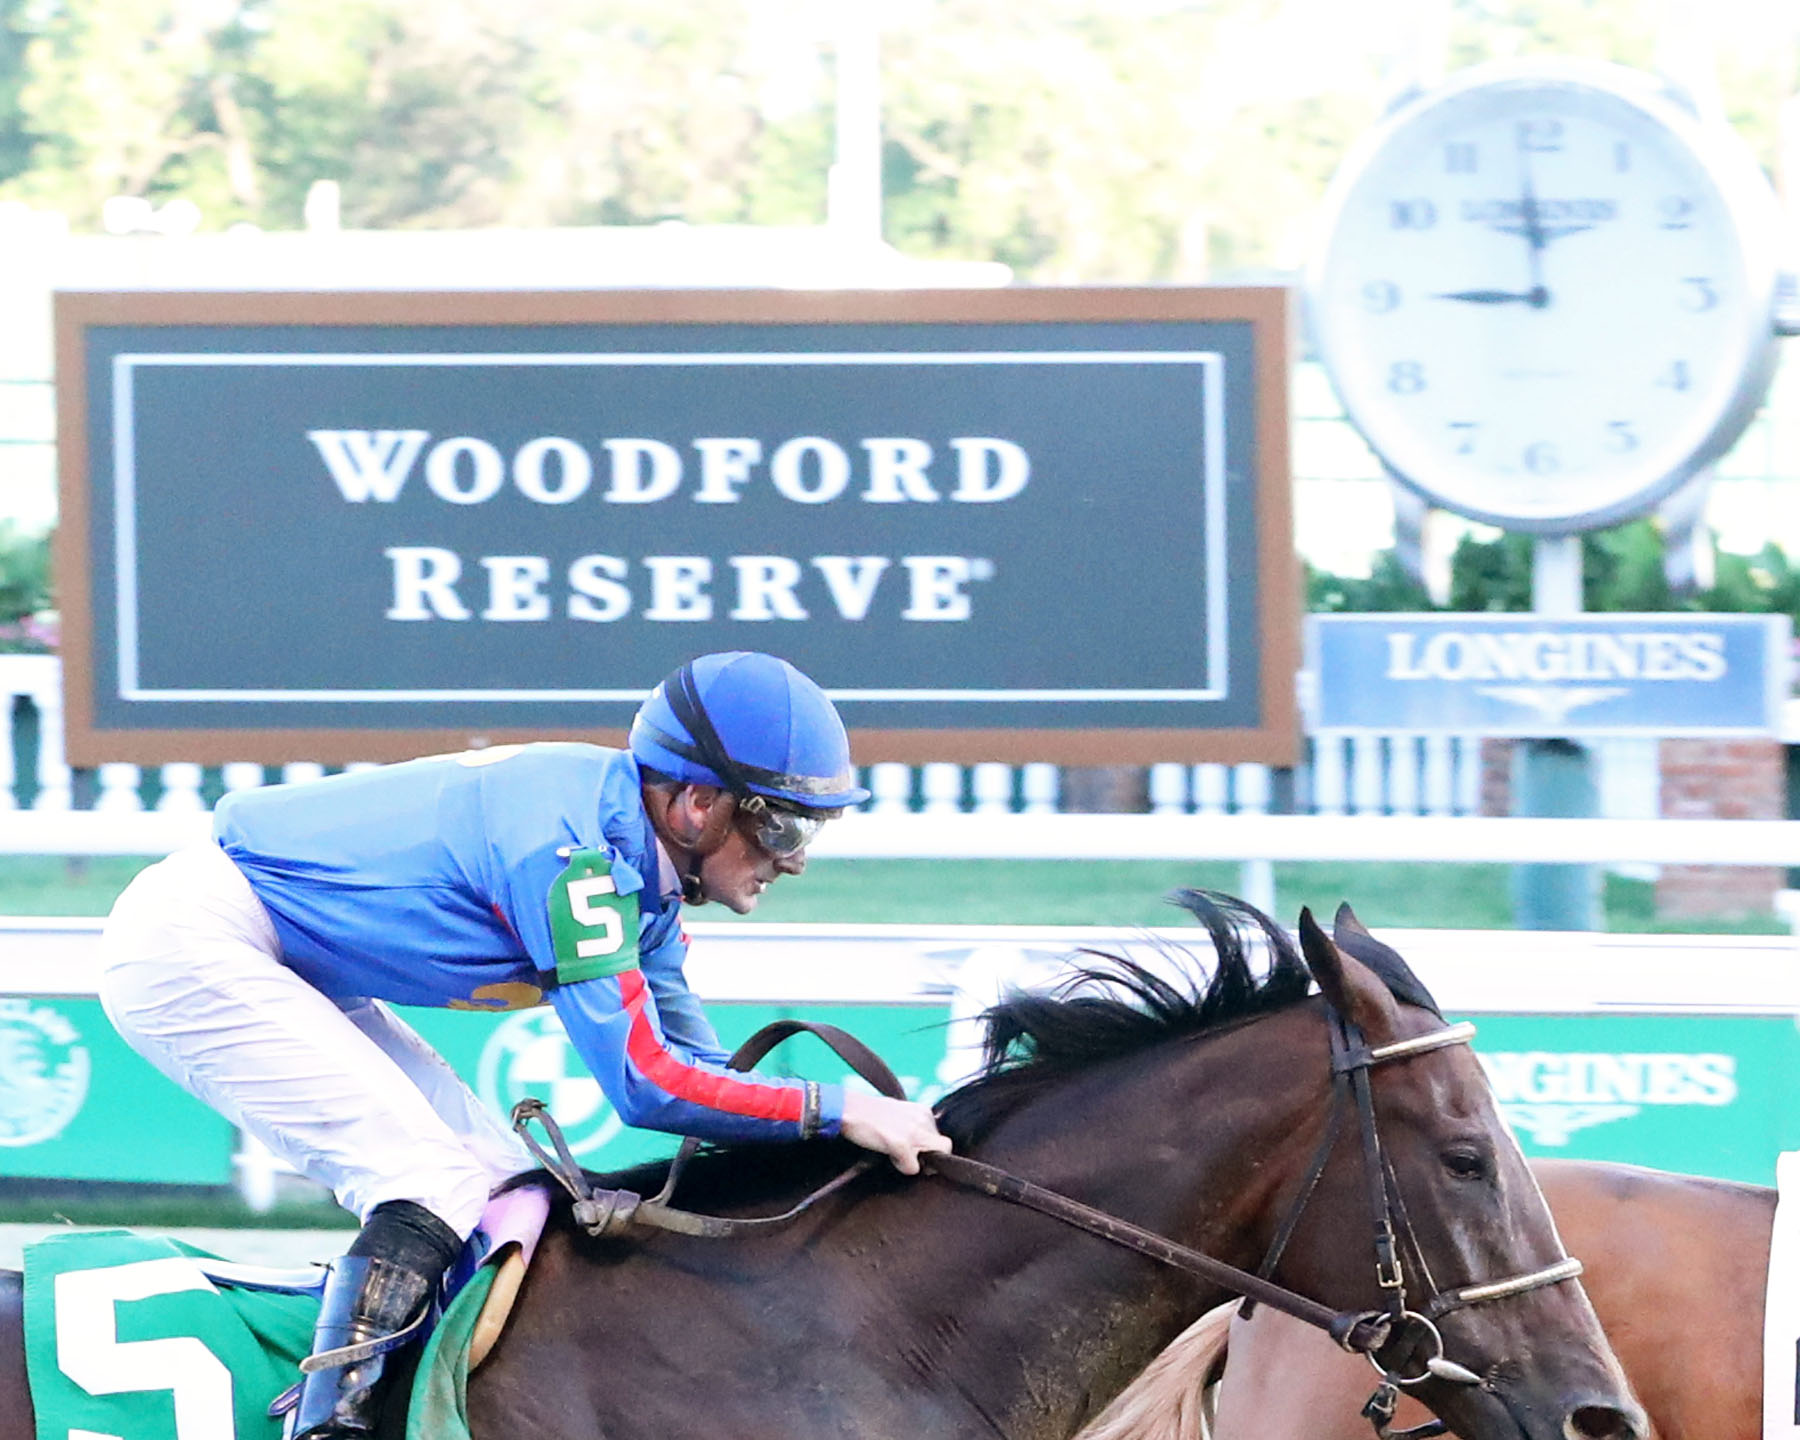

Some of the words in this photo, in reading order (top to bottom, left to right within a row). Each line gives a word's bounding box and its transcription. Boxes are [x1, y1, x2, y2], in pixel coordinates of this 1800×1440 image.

[307, 427, 1033, 506] WOODFORD
[1385, 631, 1728, 682] LONGINES
[566, 874, 625, 959] 5
[1472, 1051, 1738, 1107] NGINES
